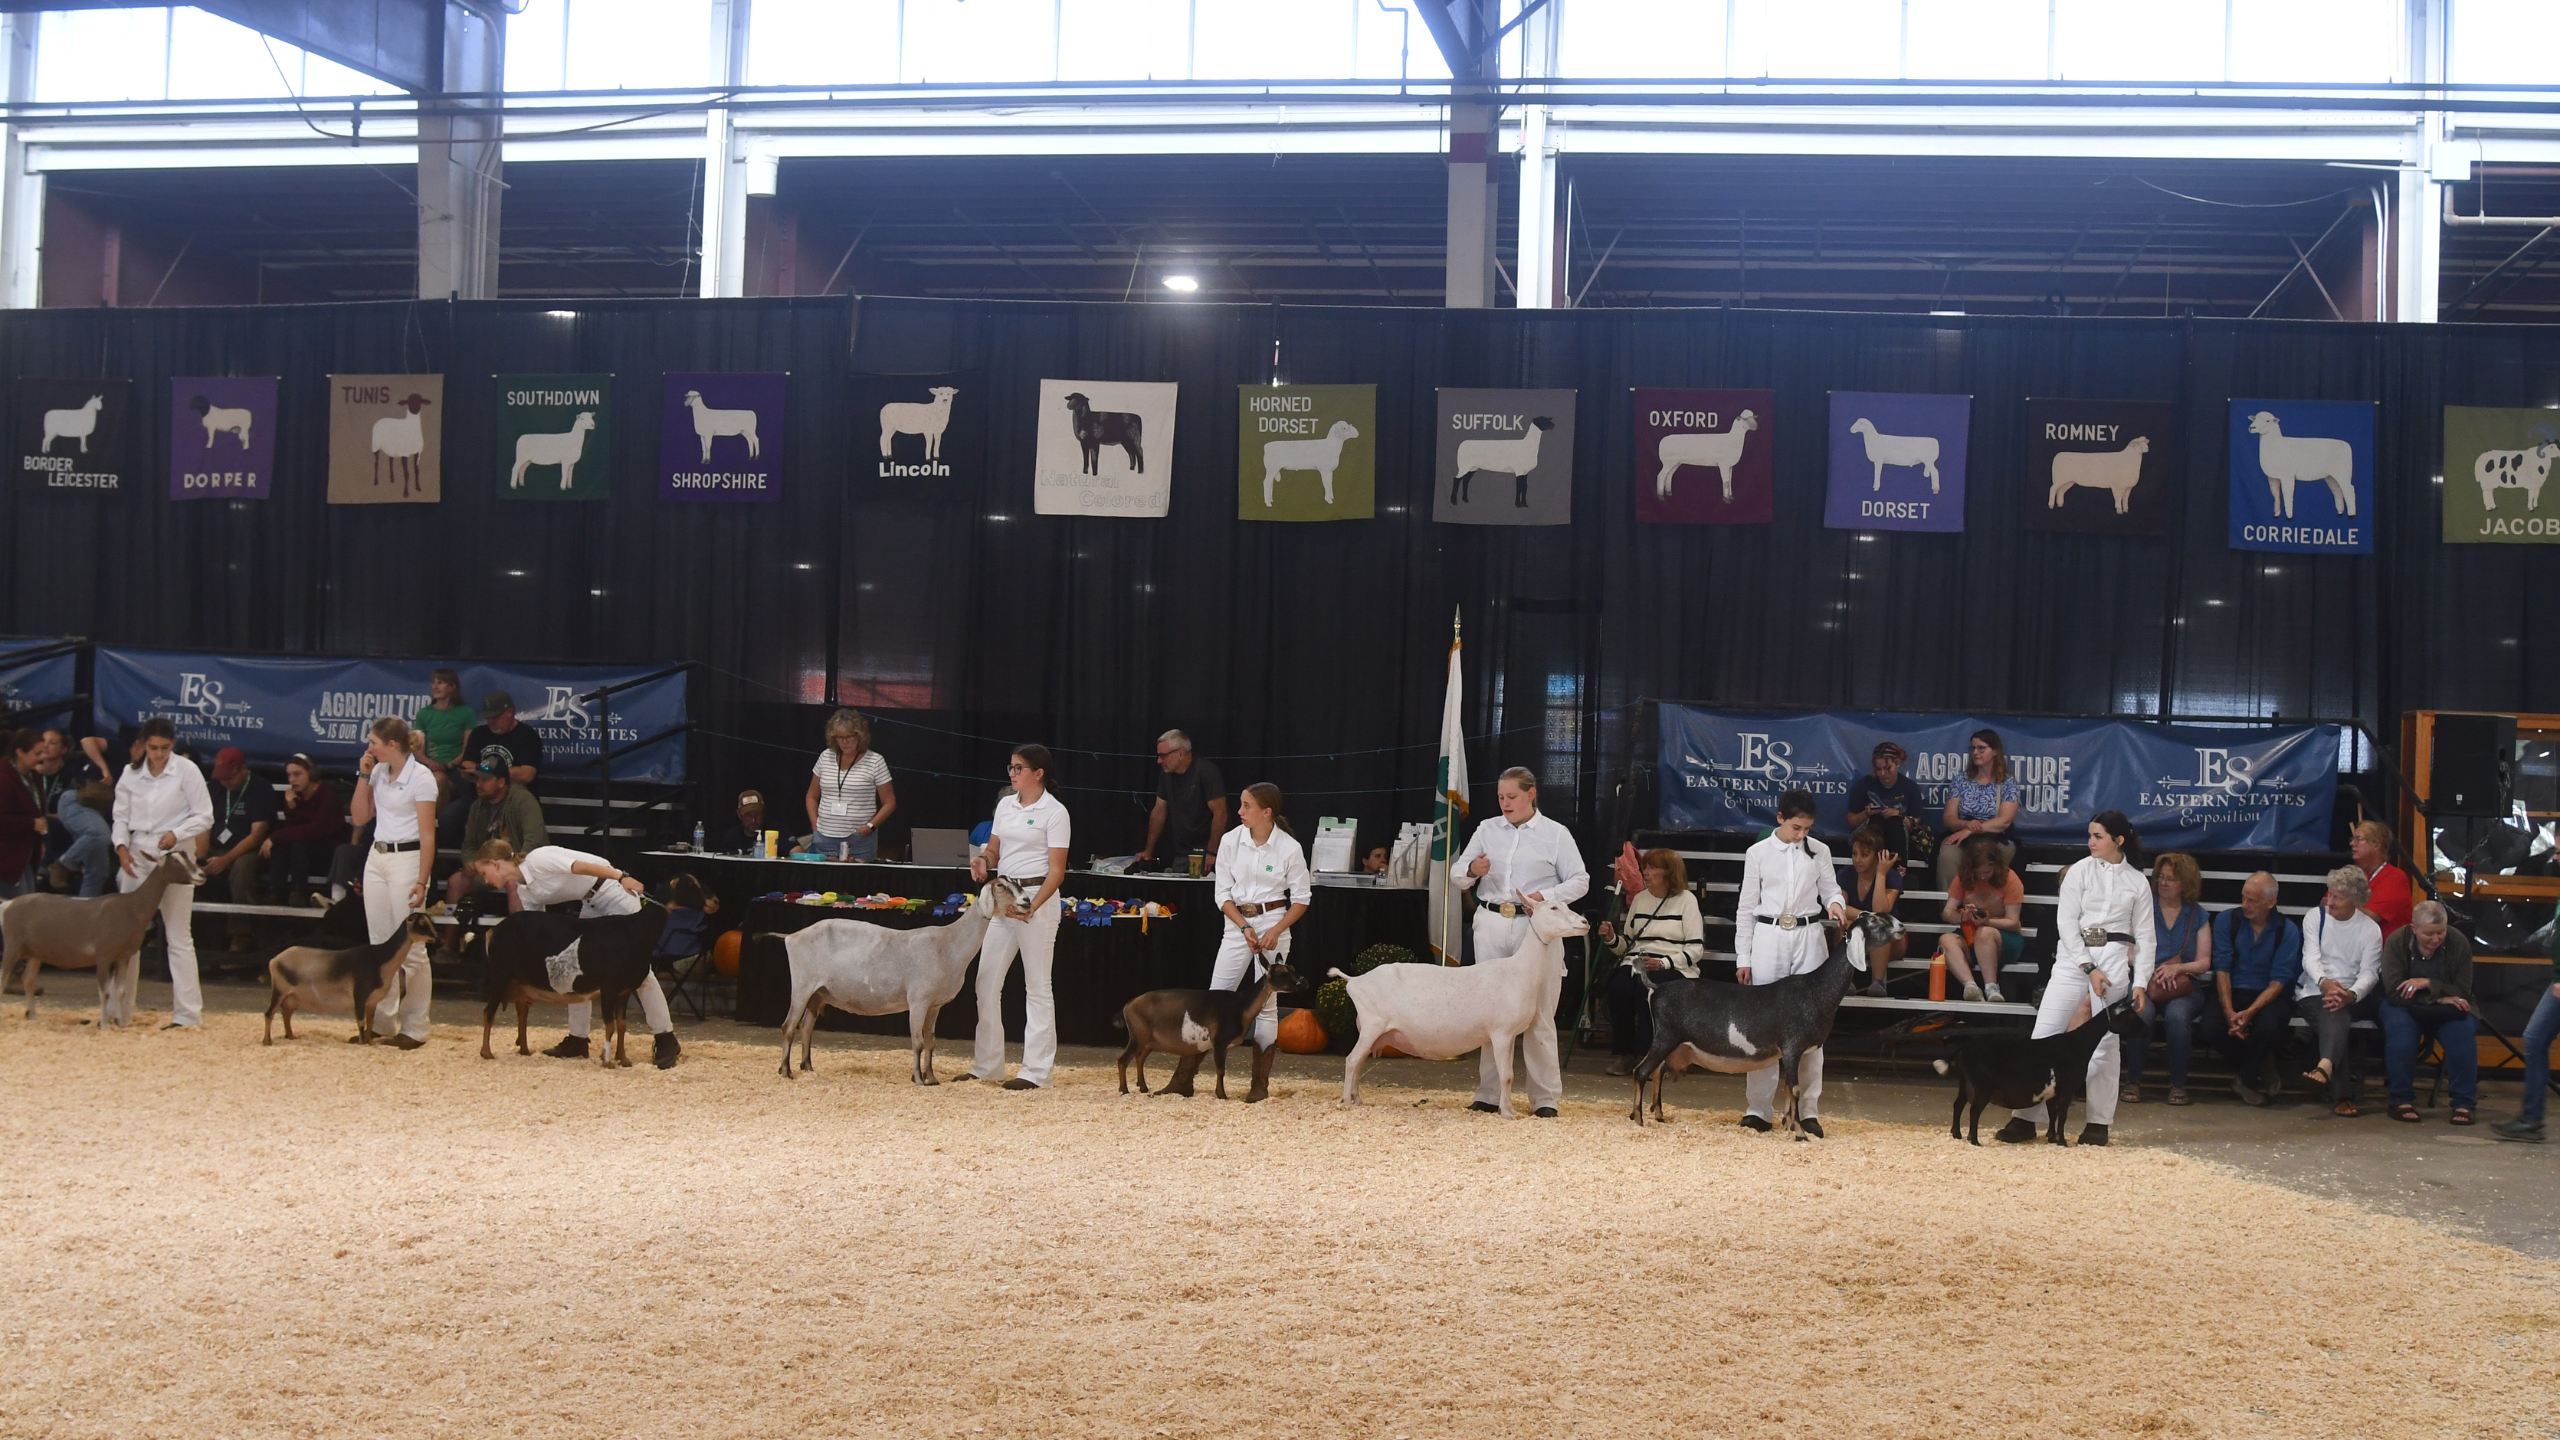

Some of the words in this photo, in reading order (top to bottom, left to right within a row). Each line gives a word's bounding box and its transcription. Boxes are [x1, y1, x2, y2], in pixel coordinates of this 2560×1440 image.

[342, 386, 390, 404] TUNIS
[507, 390, 600, 406] SOUTHDOWN
[1250, 397, 1312, 412] HORNED
[1258, 417, 1319, 434] DORSET
[1452, 413, 1524, 430] SUFFOLK
[1649, 410, 1718, 428] OXFORD
[2045, 423, 2119, 441] ROMNEY
[23, 456, 74, 471] BORDER
[879, 460, 950, 477] Lincoln
[48, 472, 119, 489] LEICESTER
[184, 472, 257, 488] DORPER
[672, 472, 767, 489] SHROPSHIRE
[1041, 469, 1120, 489] Natural
[1079, 490, 1161, 509] Colored
[1861, 500, 1931, 519] DORSET
[2244, 525, 2359, 545] CORRIEDALE
[2480, 518, 2560, 535] JACOB
[178, 673, 224, 717] ES
[210, 715, 264, 729] STATES
[327, 723, 337, 739] IS
[338, 723, 357, 740] OUR
[541, 743, 601, 762] xposition
[1736, 732, 1793, 782] ES
[2194, 748, 2254, 797] ES
[1686, 775, 1769, 792] EASTERN
[1778, 780, 1847, 795] STATES
[1929, 787, 1939, 805] IS
[2139, 792, 2229, 807] EASTERN
[2238, 793, 2306, 807] STATES
[2180, 807, 2261, 832] Exposition
